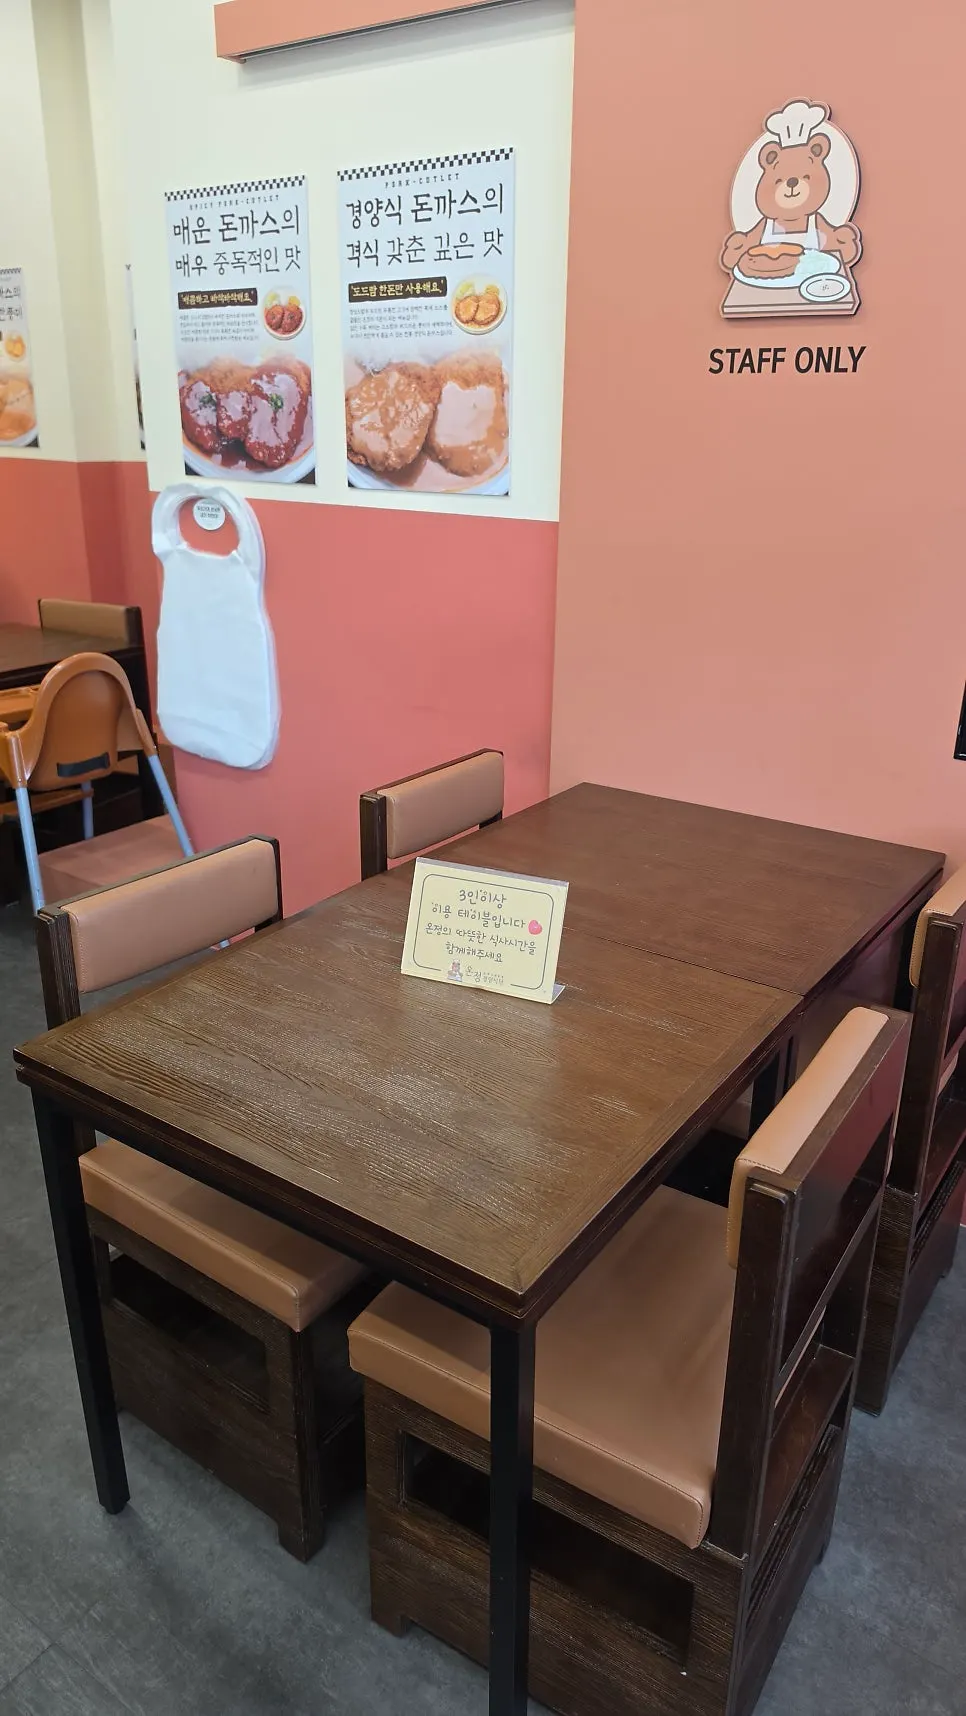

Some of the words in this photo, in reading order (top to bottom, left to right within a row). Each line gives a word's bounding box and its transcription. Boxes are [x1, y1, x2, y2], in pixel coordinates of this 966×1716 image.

[346, 195, 402, 229] 경양식
[411, 183, 503, 223] 돈까스의
[173, 216, 211, 245] 매운
[218, 204, 300, 242] 돈까스의
[175, 253, 208, 277] 매우
[213, 246, 280, 275] 중독적인
[285, 245, 301, 271] 맛
[346, 239, 379, 268] 격식
[387, 235, 426, 266] 갖춘
[433, 232, 475, 262] 깊은
[483, 228, 504, 258] 맛
[708, 347, 786, 374] STAFF
[794, 345, 867, 374] ONLY
[431, 902, 452, 919] 이용
[457, 908, 526, 928] 테이블입니다
[425, 922, 452, 936] 온정의
[455, 928, 487, 944] 따뜻한
[489, 935, 537, 956] 식사시간을
[445, 941, 503, 963] 함께해주세요
[465, 965, 482, 983] 온정
